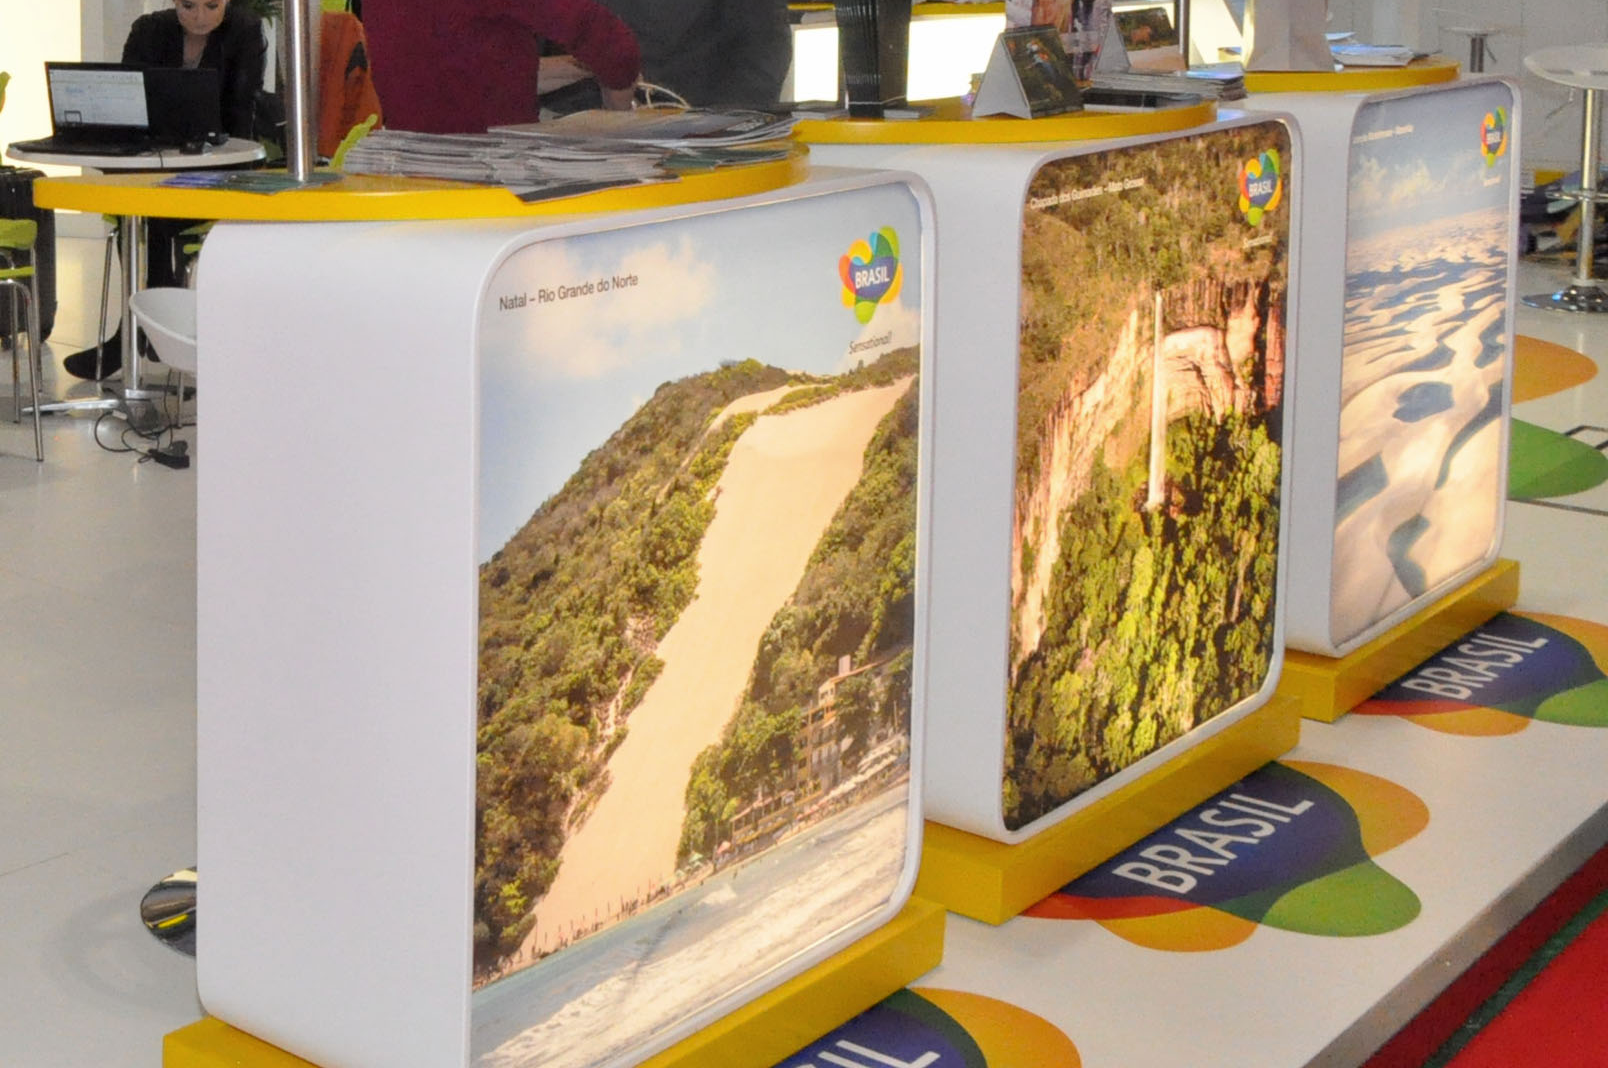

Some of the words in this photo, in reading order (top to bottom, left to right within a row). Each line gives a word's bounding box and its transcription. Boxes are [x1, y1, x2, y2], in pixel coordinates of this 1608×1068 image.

[1248, 178, 1273, 197] BRASIL
[499, 292, 527, 312] Natal
[538, 286, 556, 304] Rio
[557, 280, 595, 301] Grande
[596, 277, 610, 293] do
[611, 272, 639, 290] Norte
[854, 264, 891, 290] BRASIL
[1401, 632, 1550, 702] BRASIL
[1112, 792, 1316, 895] BRASIL
